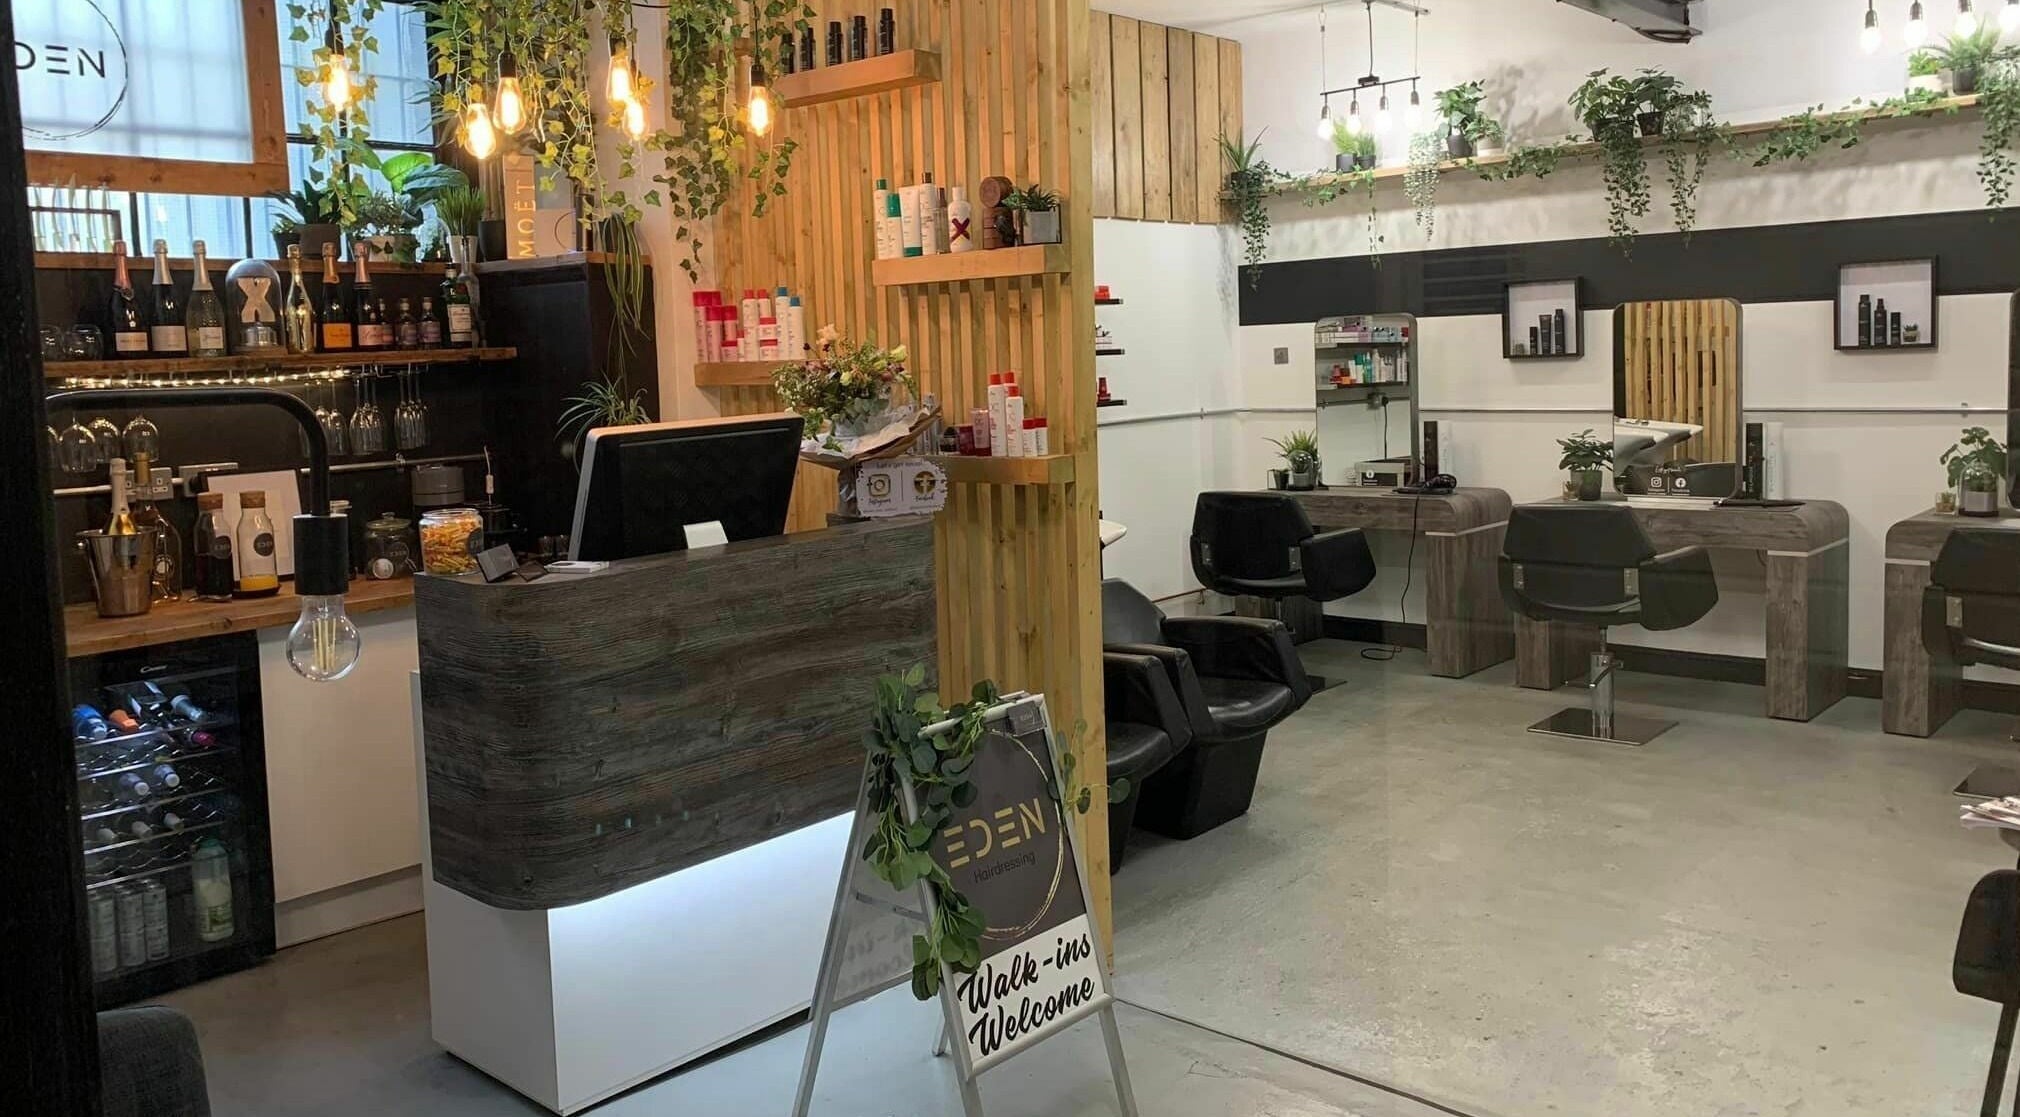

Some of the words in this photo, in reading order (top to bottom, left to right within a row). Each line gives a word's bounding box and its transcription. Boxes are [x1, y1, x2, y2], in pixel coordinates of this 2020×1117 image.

[514, 180, 537, 258] MOËT
[943, 798, 1046, 869] EDEN
[973, 851, 1036, 884] Hairdressing
[968, 976, 1095, 1056] Welcome
